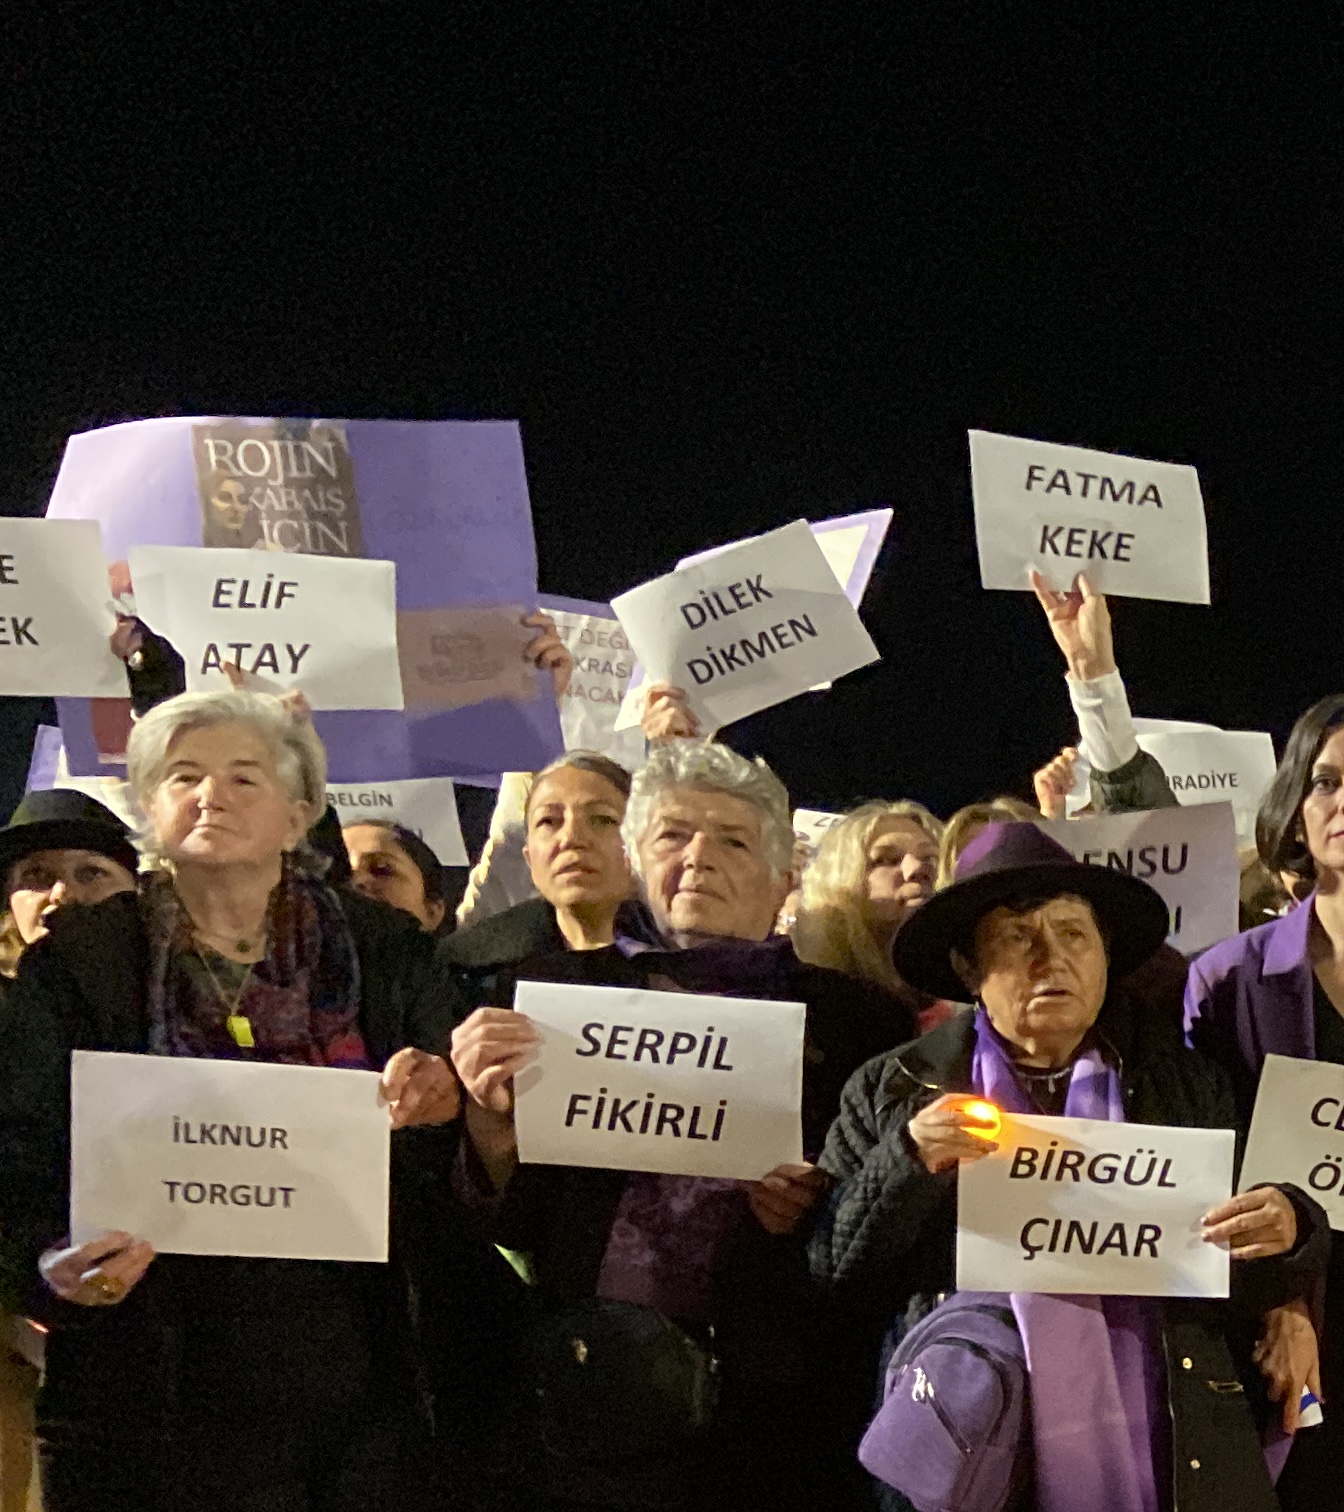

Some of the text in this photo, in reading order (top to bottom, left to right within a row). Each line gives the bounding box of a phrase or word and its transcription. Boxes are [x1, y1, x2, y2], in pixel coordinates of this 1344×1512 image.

[1024, 464, 1165, 510] FATMA
[1038, 523, 1135, 563] KEKE
[212, 573, 299, 609] ELİF
[680, 574, 774, 630] DİLEK
[201, 642, 311, 675] ATAY
[687, 613, 818, 685] DİKMEN
[575, 1021, 734, 1072] SERPİL
[172, 1116, 289, 1150] İLKNUR
[564, 1086, 727, 1143] FİKİRLİ
[1009, 1141, 1178, 1188] BİRGÜL
[163, 1179, 297, 1210] TORGUT
[1020, 1217, 1163, 1261] ÇINAR
